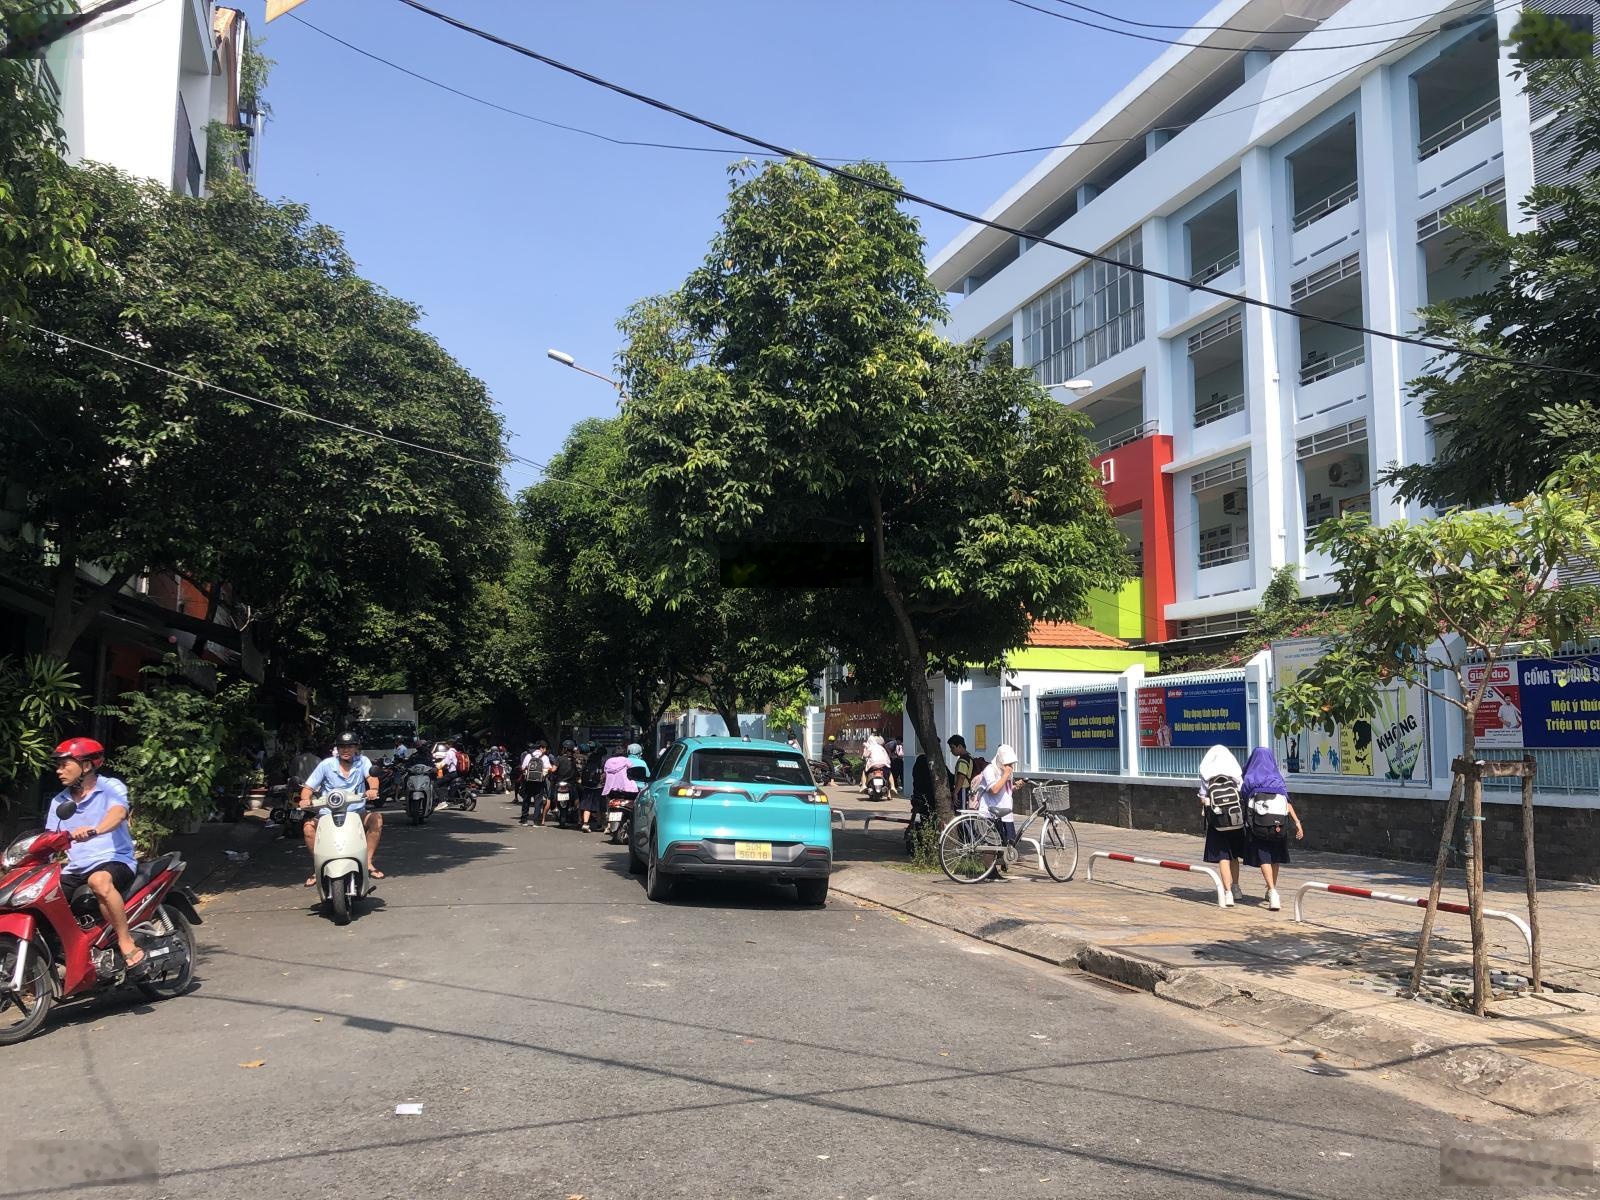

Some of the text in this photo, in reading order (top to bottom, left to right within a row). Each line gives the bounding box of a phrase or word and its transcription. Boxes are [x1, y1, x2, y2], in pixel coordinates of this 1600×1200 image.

[1470, 669, 1508, 681] giá dục
[1524, 667, 1550, 685] CỔNG
[1551, 700, 1571, 714] Một
[1572, 699, 1578, 713] ý
[1089, 716, 1101, 726] công
[1546, 718, 1573, 733] Triệu
[1574, 720, 1588, 733] nụ
[1376, 714, 1418, 752] KHÔNG
